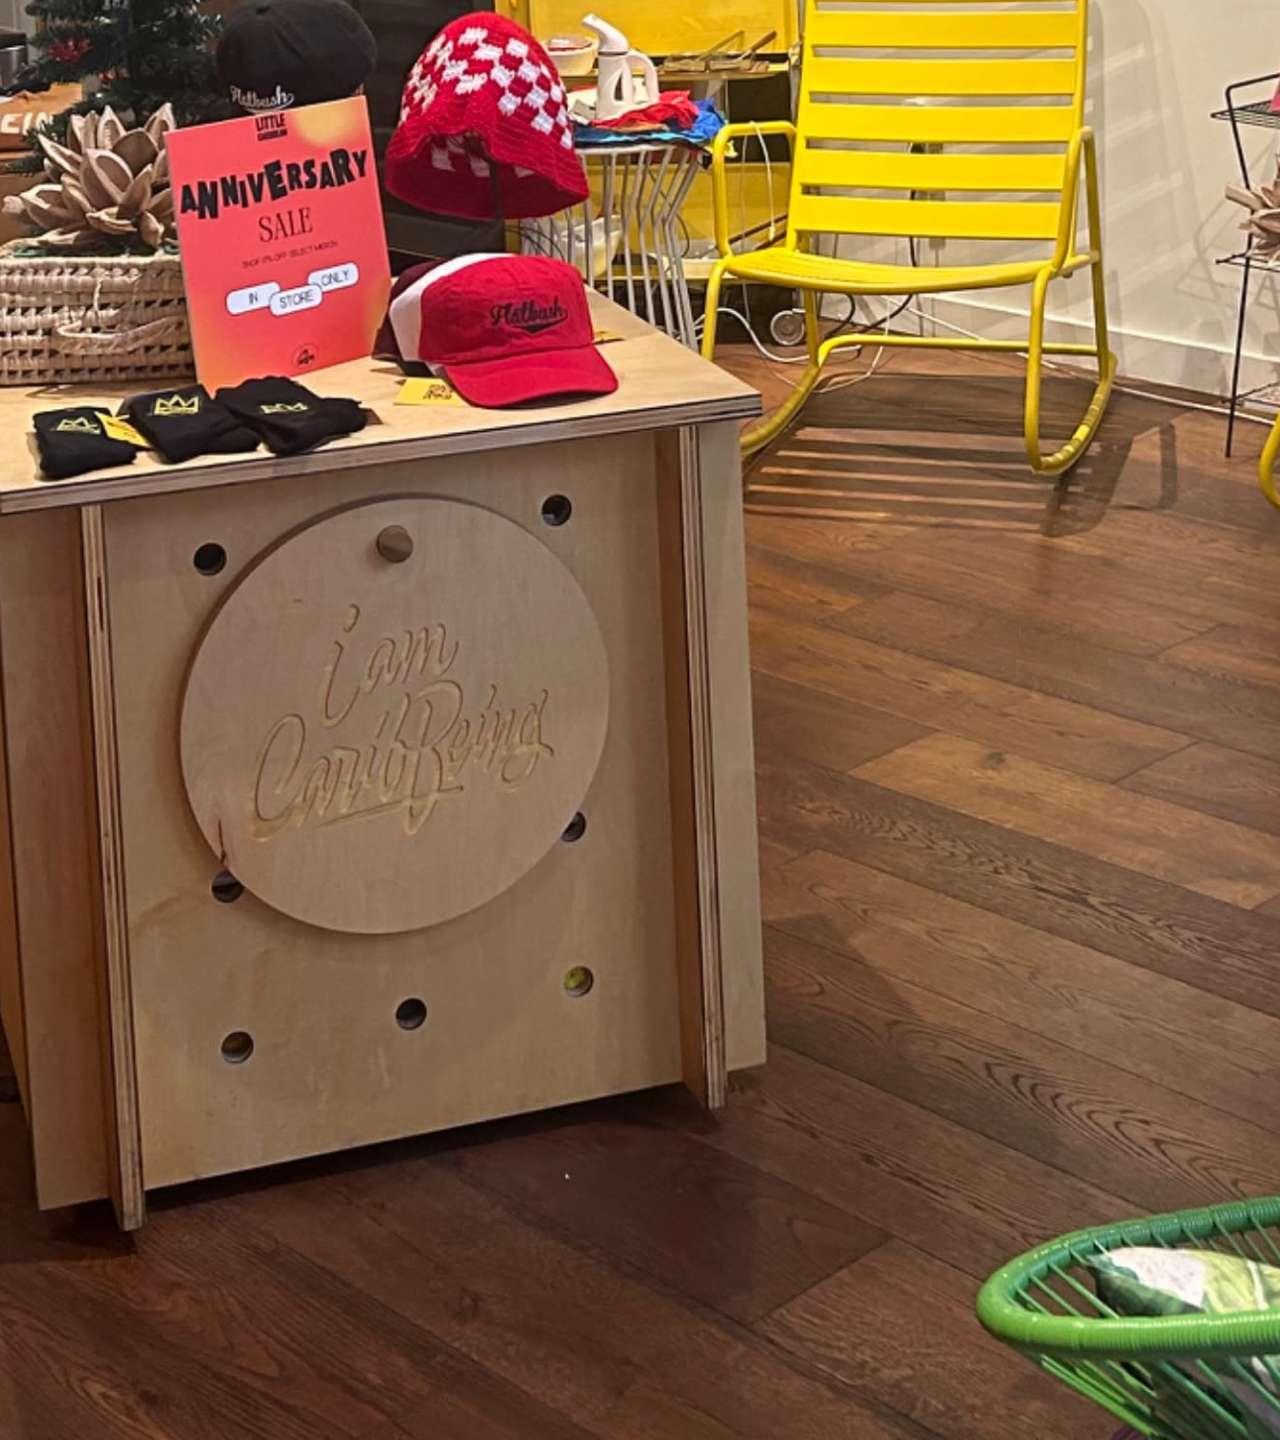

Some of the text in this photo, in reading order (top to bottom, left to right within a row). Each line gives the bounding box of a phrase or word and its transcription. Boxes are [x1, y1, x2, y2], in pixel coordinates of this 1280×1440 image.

[255, 113, 286, 132] LITTLE
[180, 148, 367, 219] ANNIVERSARY
[258, 207, 313, 243] SALE
[248, 269, 350, 308] IN STORE ONLY
[364, 623, 460, 694] am
